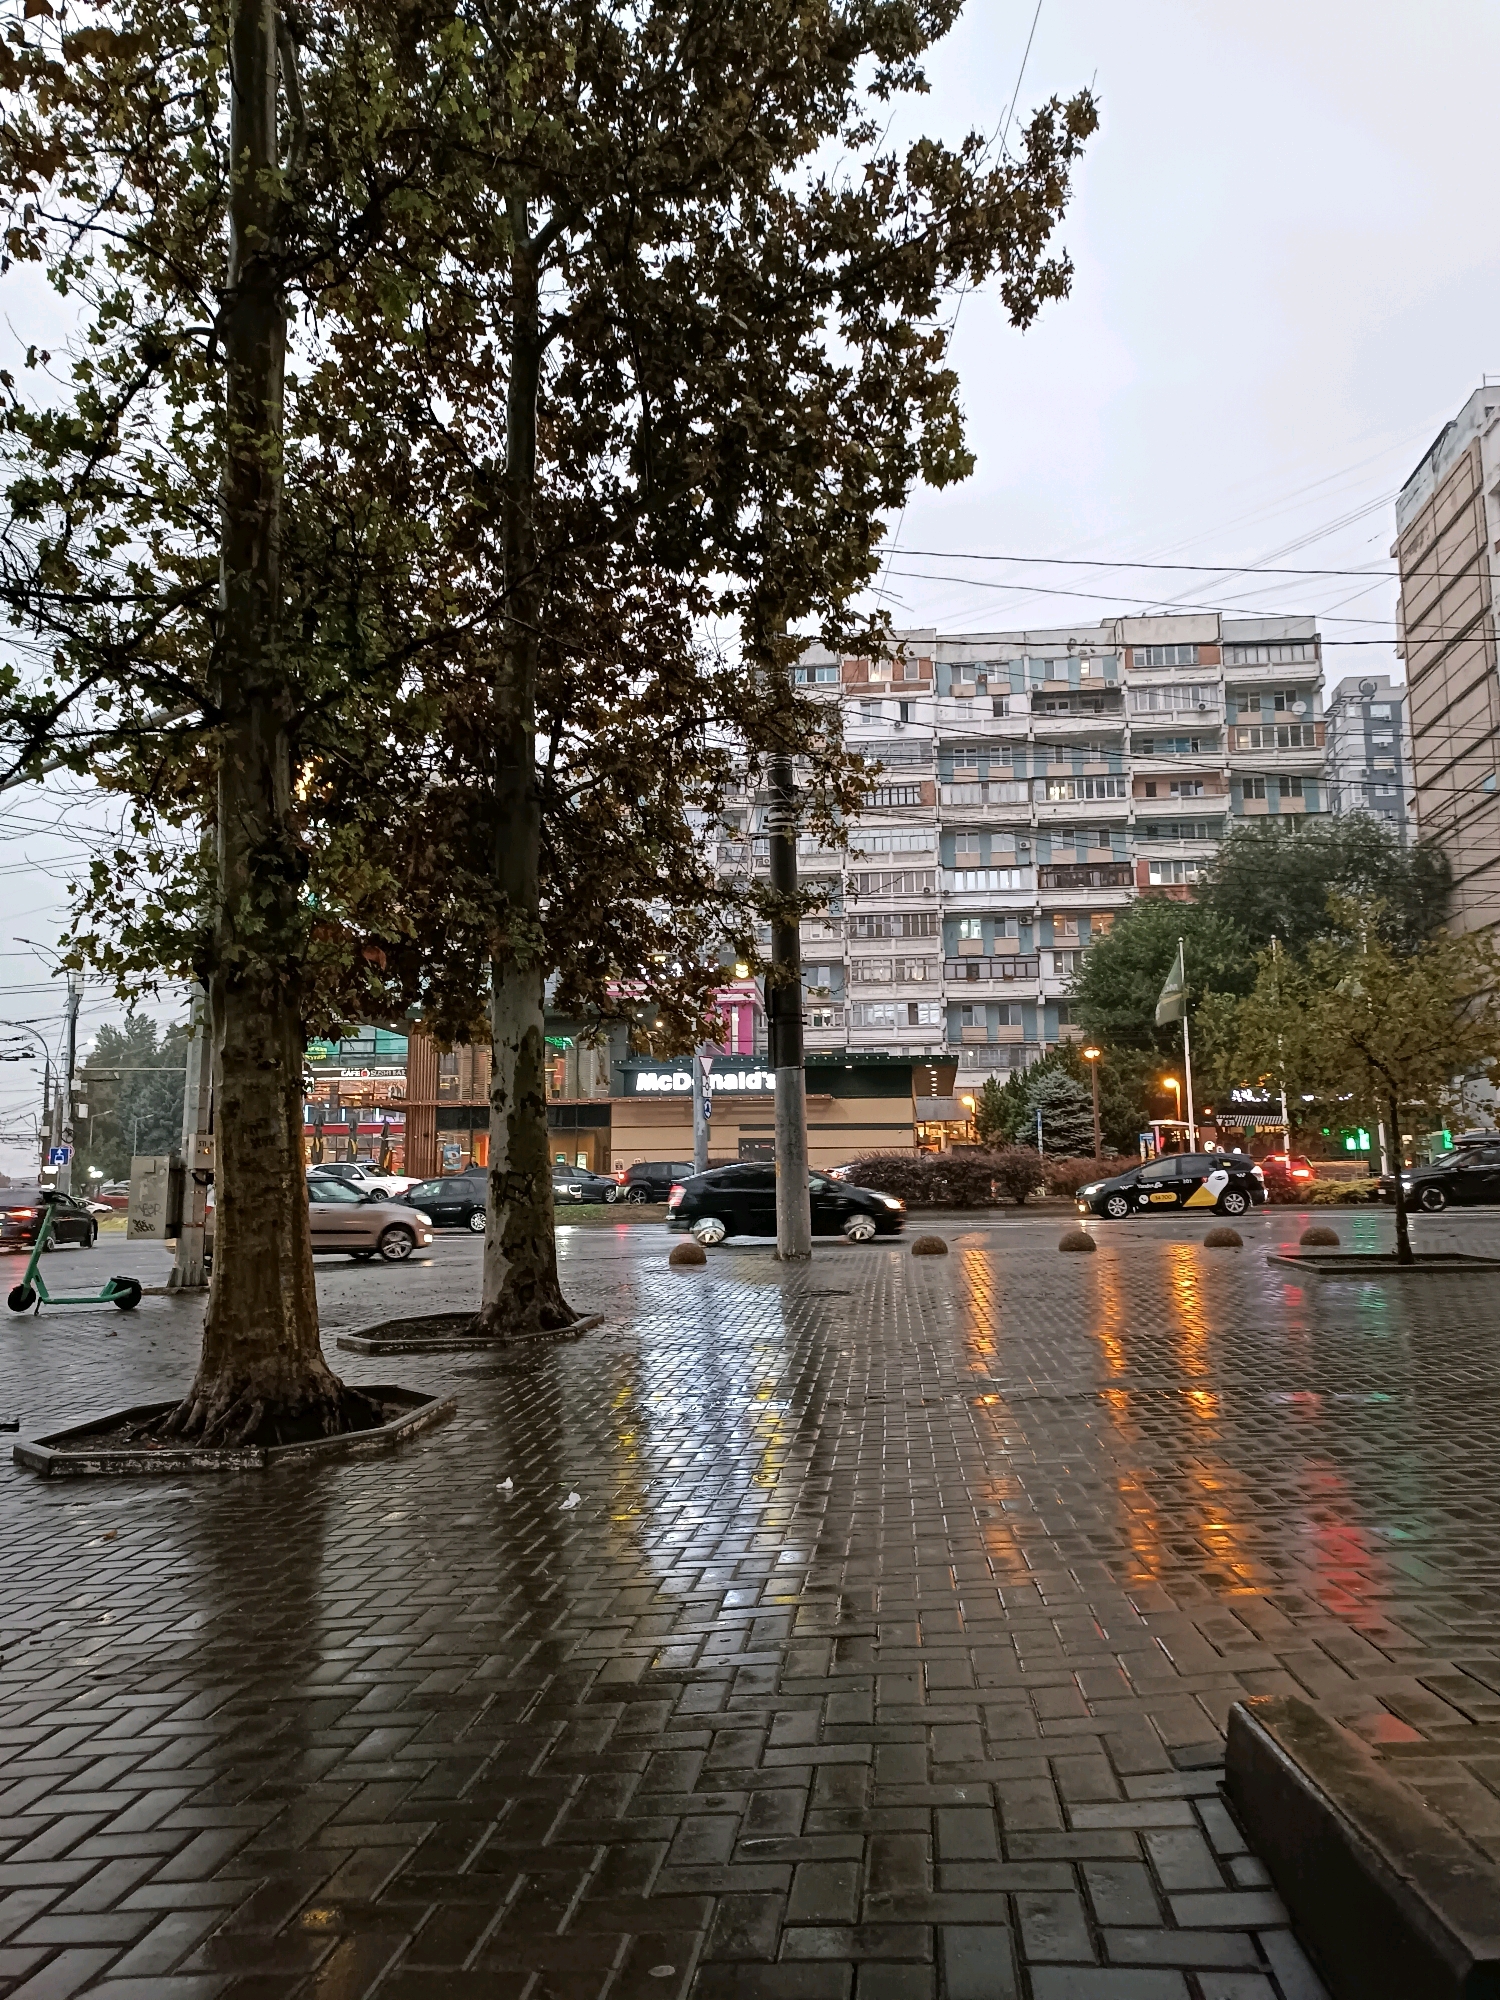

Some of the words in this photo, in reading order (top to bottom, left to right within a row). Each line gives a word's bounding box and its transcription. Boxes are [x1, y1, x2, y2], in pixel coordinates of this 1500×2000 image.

[340, 1069, 360, 1077] CAFE
[370, 1069, 392, 1077] SUSHI
[636, 1071, 777, 1091] McDnald's
